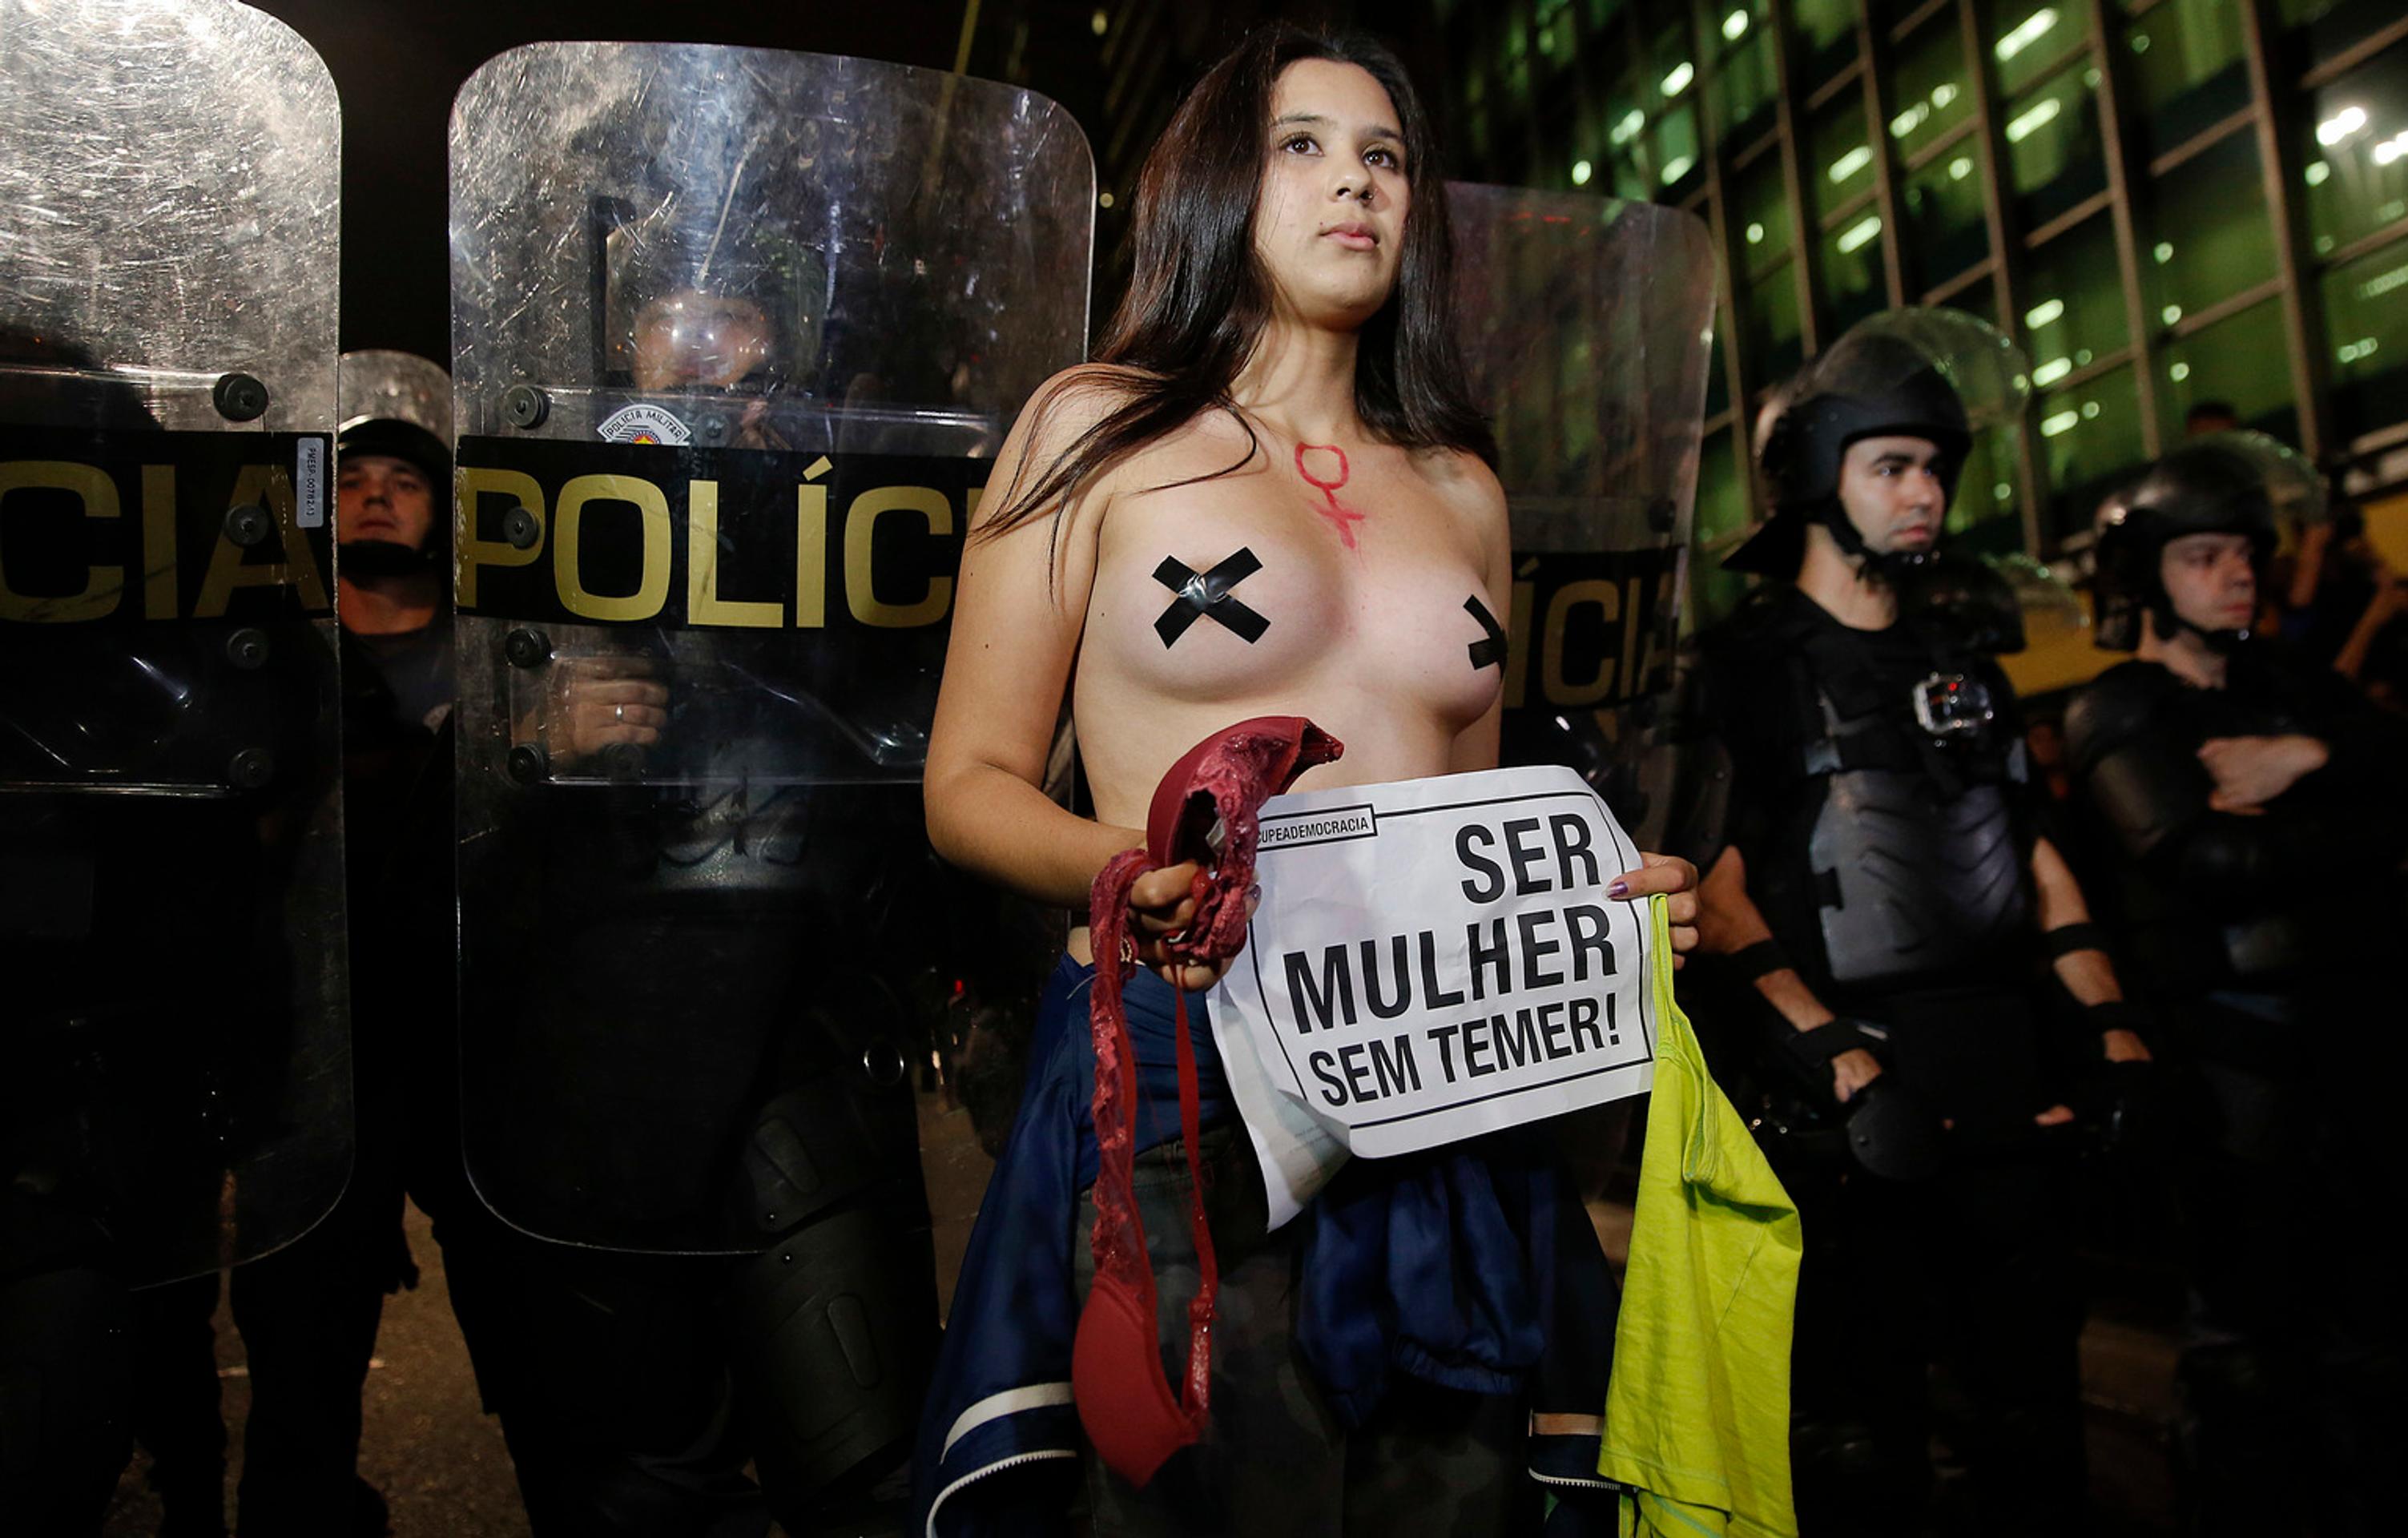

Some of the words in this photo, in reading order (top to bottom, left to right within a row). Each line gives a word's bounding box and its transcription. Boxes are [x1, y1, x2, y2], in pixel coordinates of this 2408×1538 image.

[646, 411, 683, 438] MILITAR
[457, 455, 984, 628] POLÍC
[1456, 813, 1601, 904] SER
[1283, 904, 1617, 1034] MULHER
[1309, 1034, 1422, 1107] SEM
[1428, 992, 1620, 1083] TEMER!
